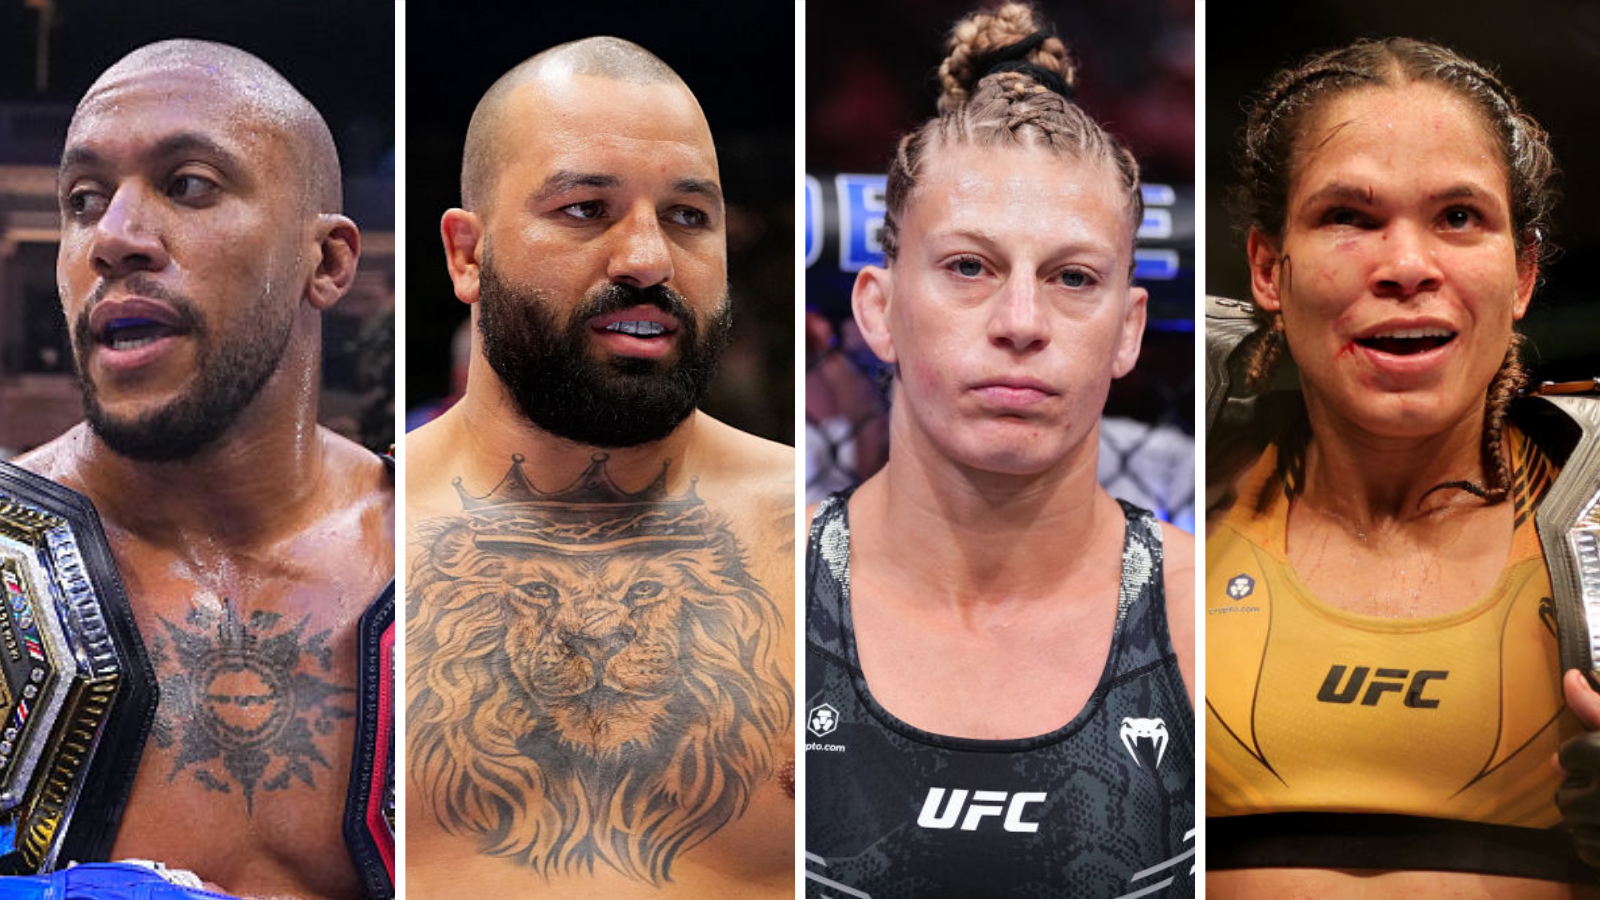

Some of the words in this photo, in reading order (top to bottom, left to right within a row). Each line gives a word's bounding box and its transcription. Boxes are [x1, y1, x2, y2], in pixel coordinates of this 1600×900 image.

[1316, 664, 1449, 709] UFC
[805, 742, 846, 753] pto.com
[916, 786, 1048, 833] UFC
